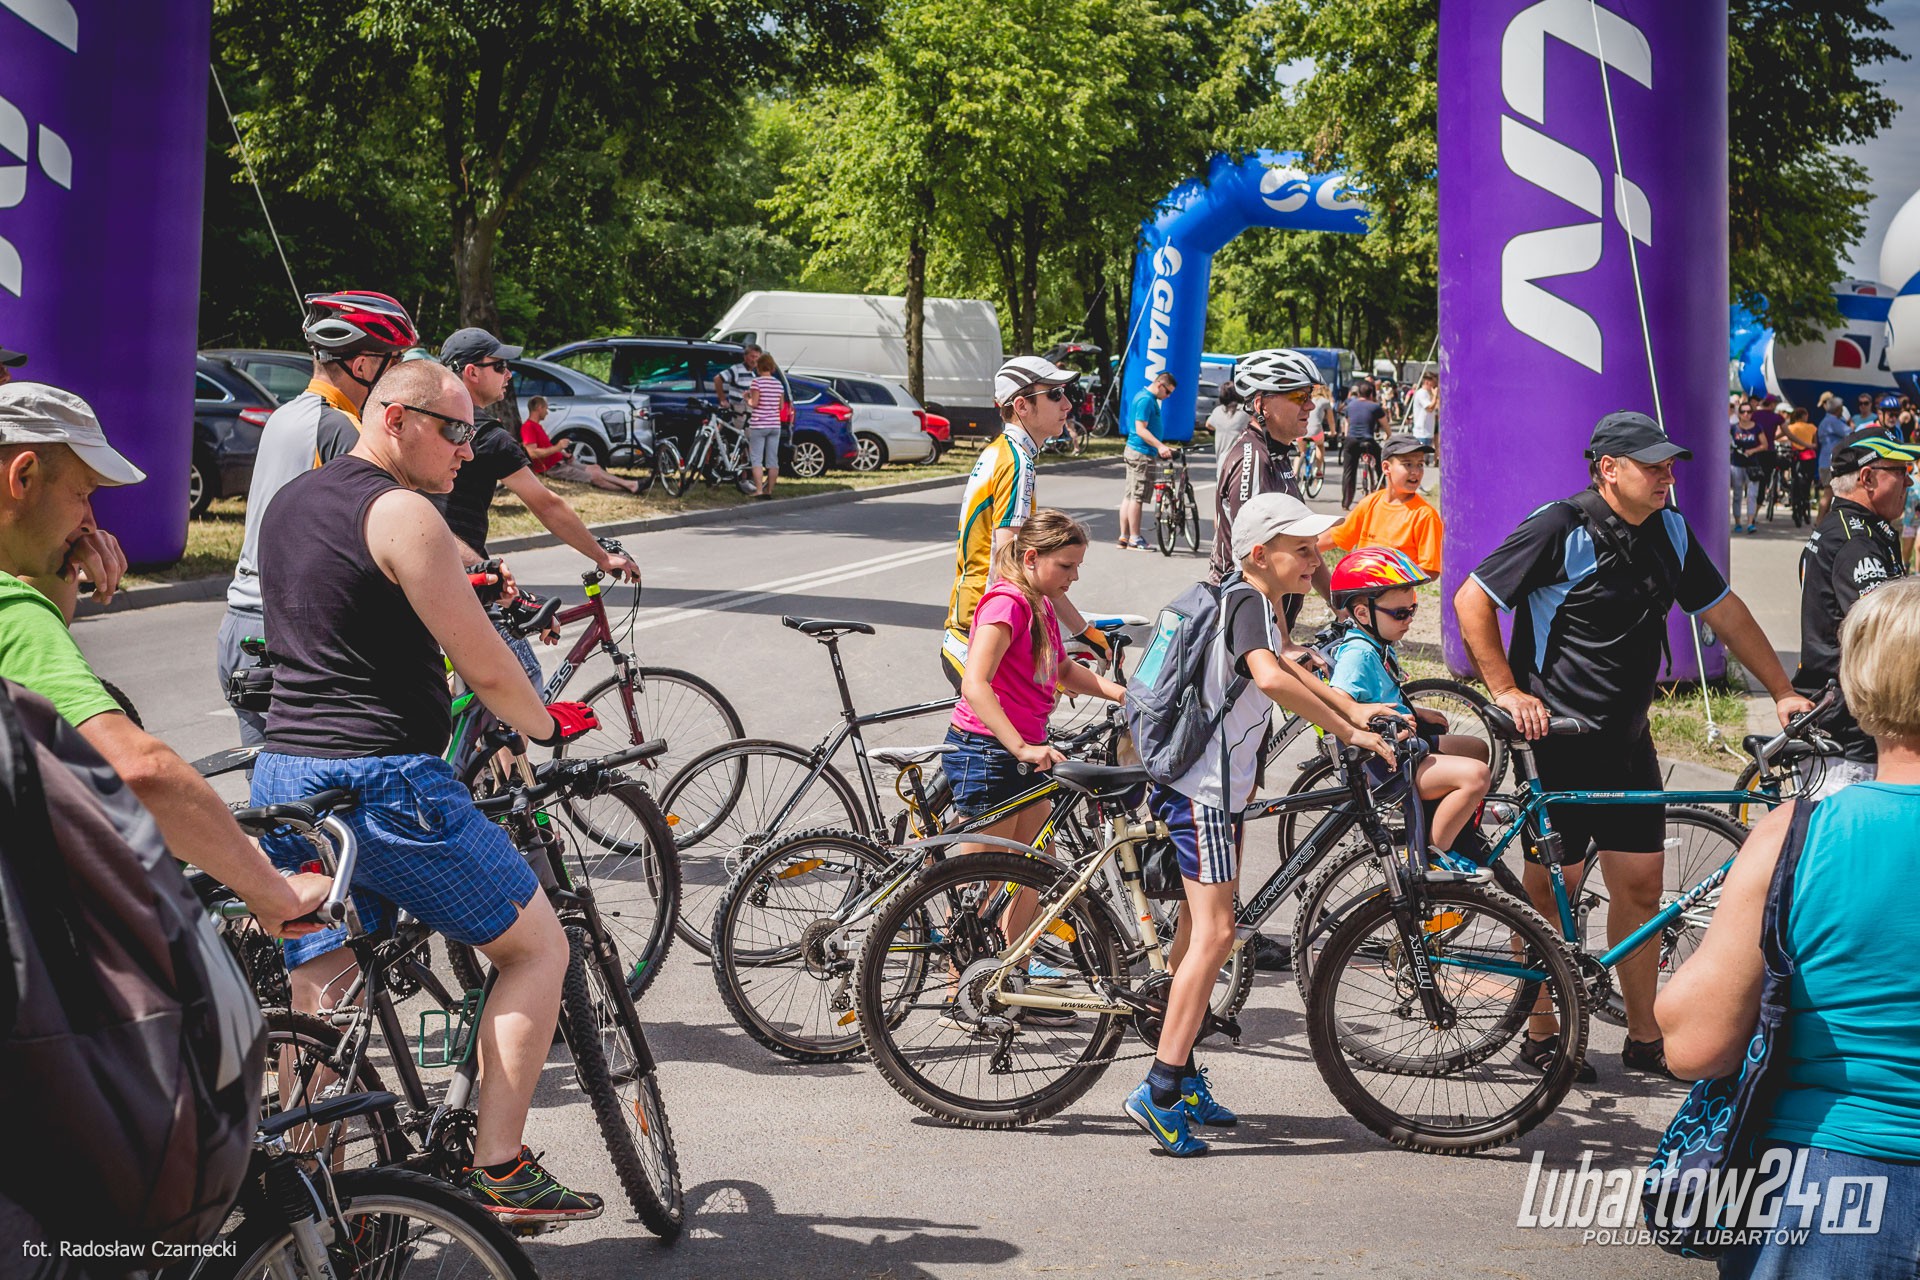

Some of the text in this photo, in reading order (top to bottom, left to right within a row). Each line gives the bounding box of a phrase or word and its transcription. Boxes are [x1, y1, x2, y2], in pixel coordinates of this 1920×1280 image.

[1143, 278, 1174, 386] GIAN
[1853, 556, 1887, 579] MAC
[1244, 841, 1317, 922] KROSS
